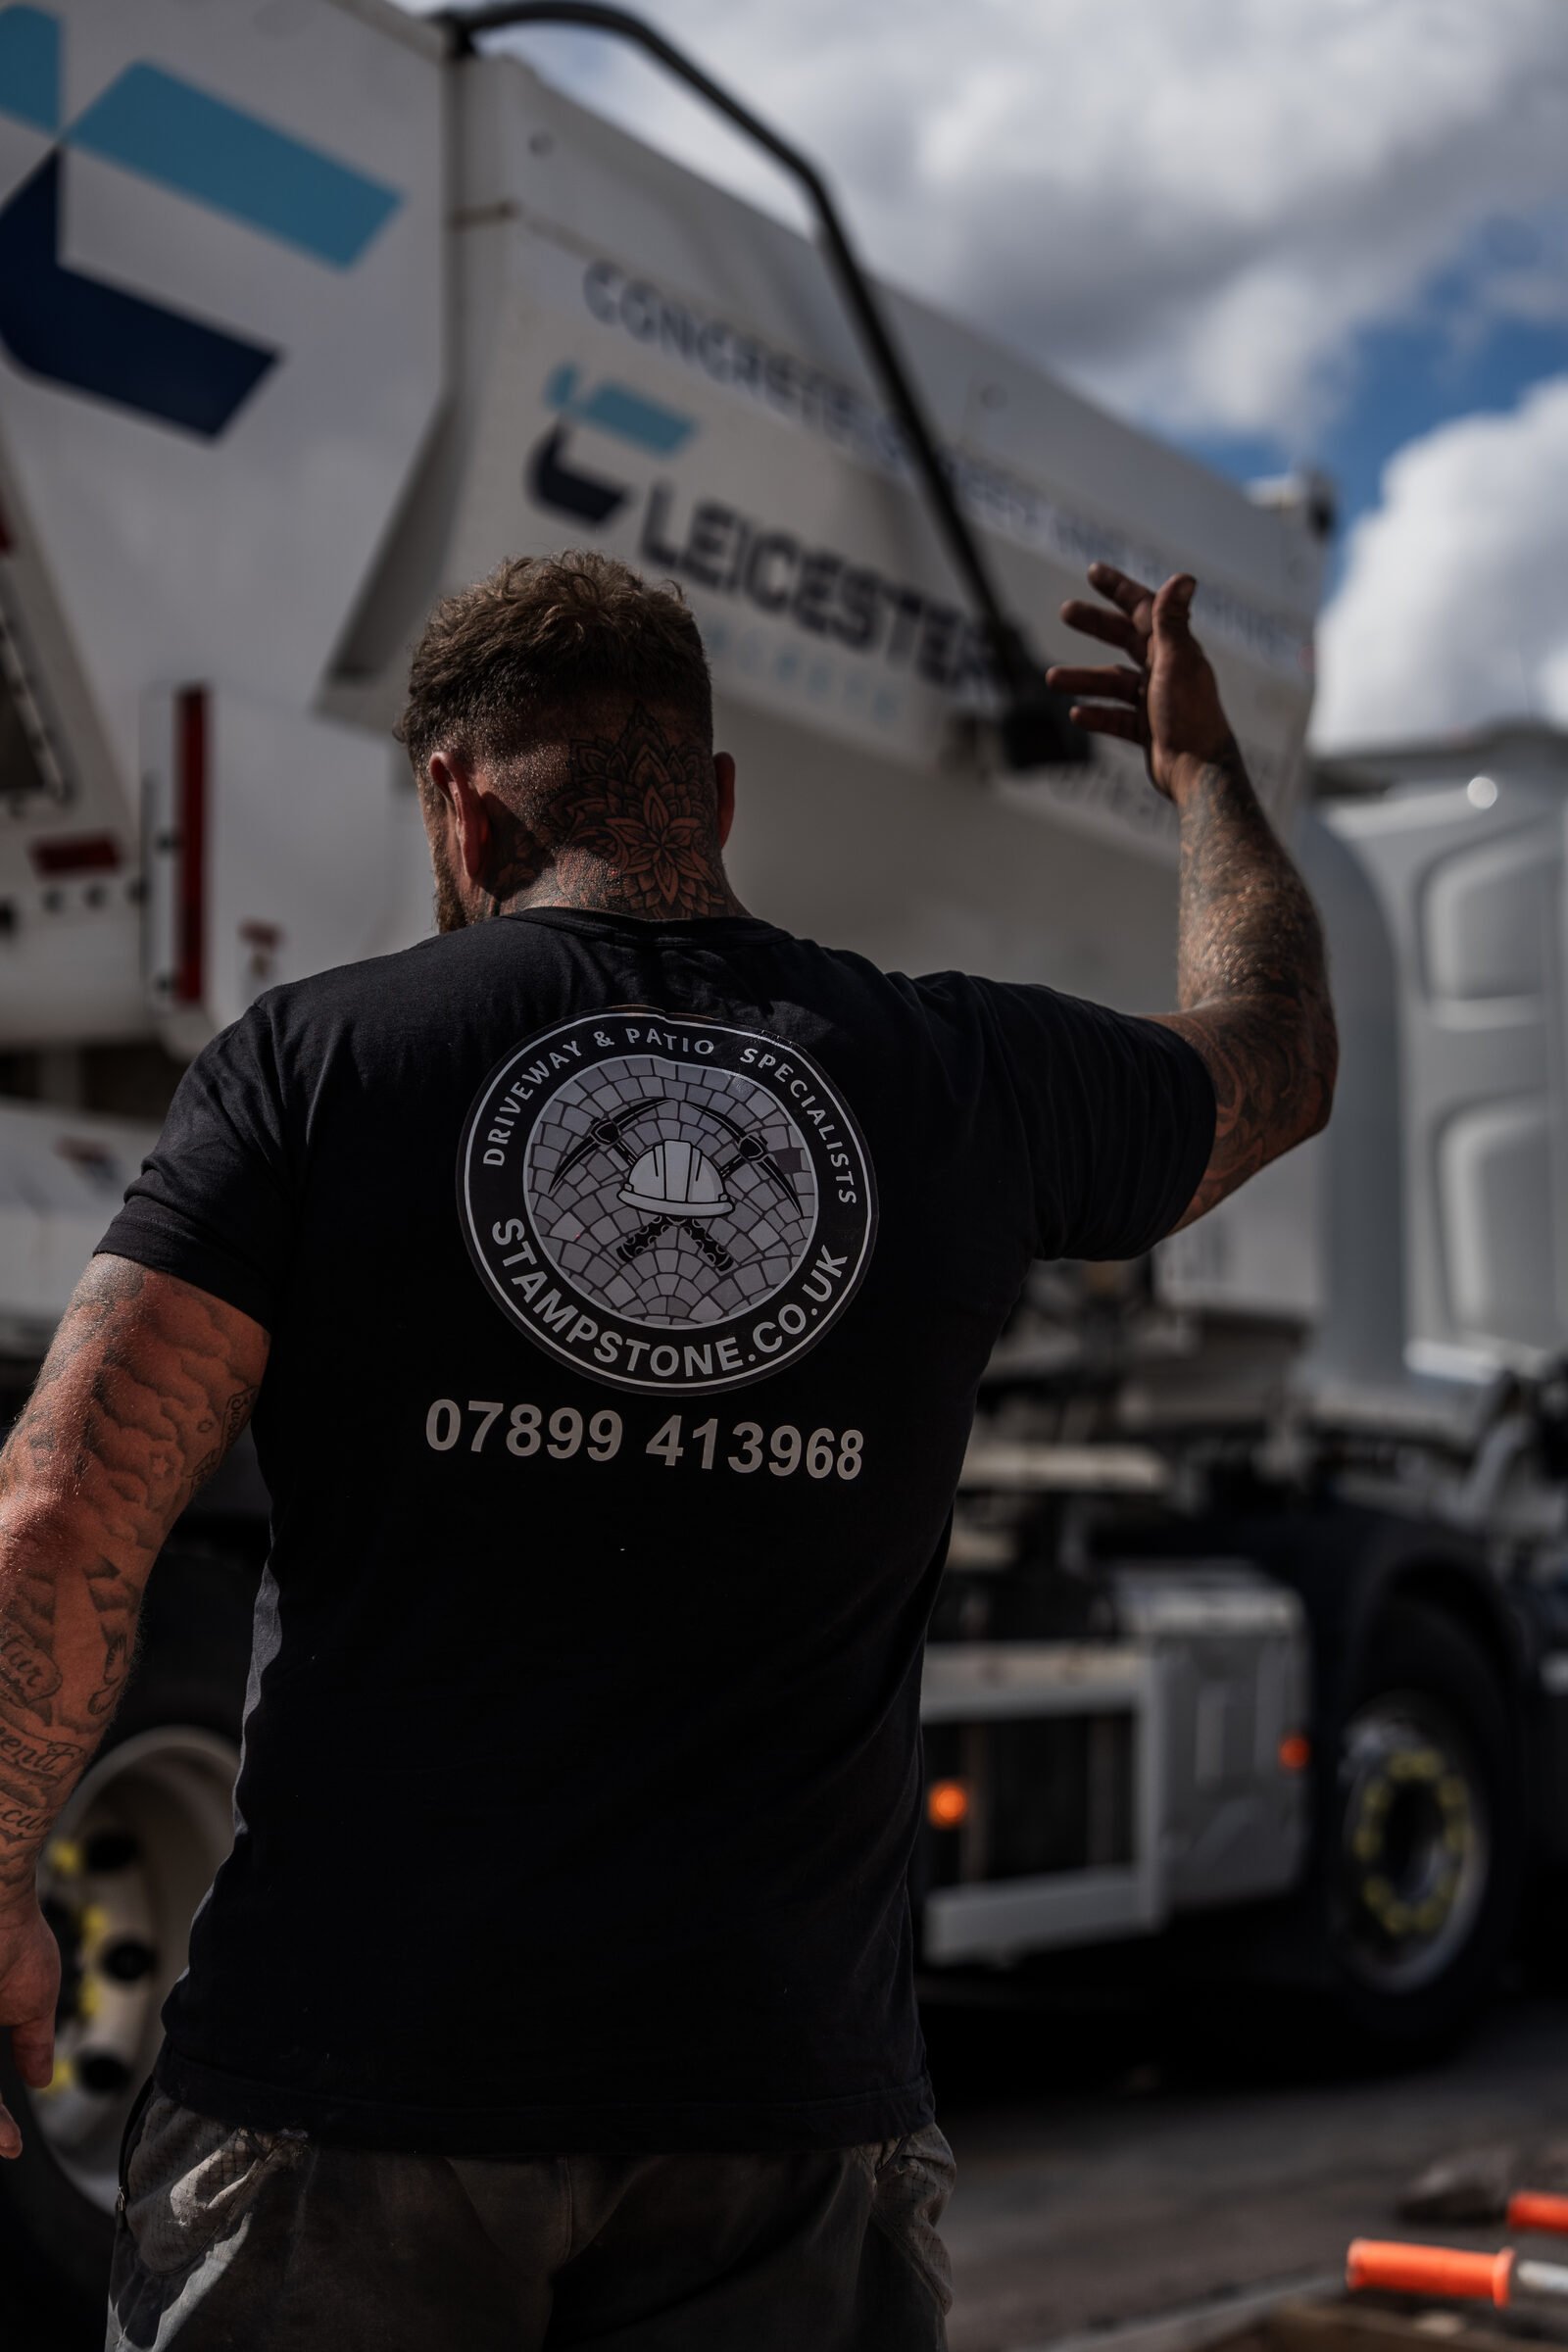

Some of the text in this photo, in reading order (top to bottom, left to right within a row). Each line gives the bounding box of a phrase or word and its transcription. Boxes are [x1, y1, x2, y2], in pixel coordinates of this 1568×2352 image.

[482, 1027, 858, 1205] DRIVEWAY & PATIO SPECIALISTS
[492, 1217, 849, 1378] STAMPSTONE.CO.UK
[425, 1398, 864, 1481] 07899 413968
